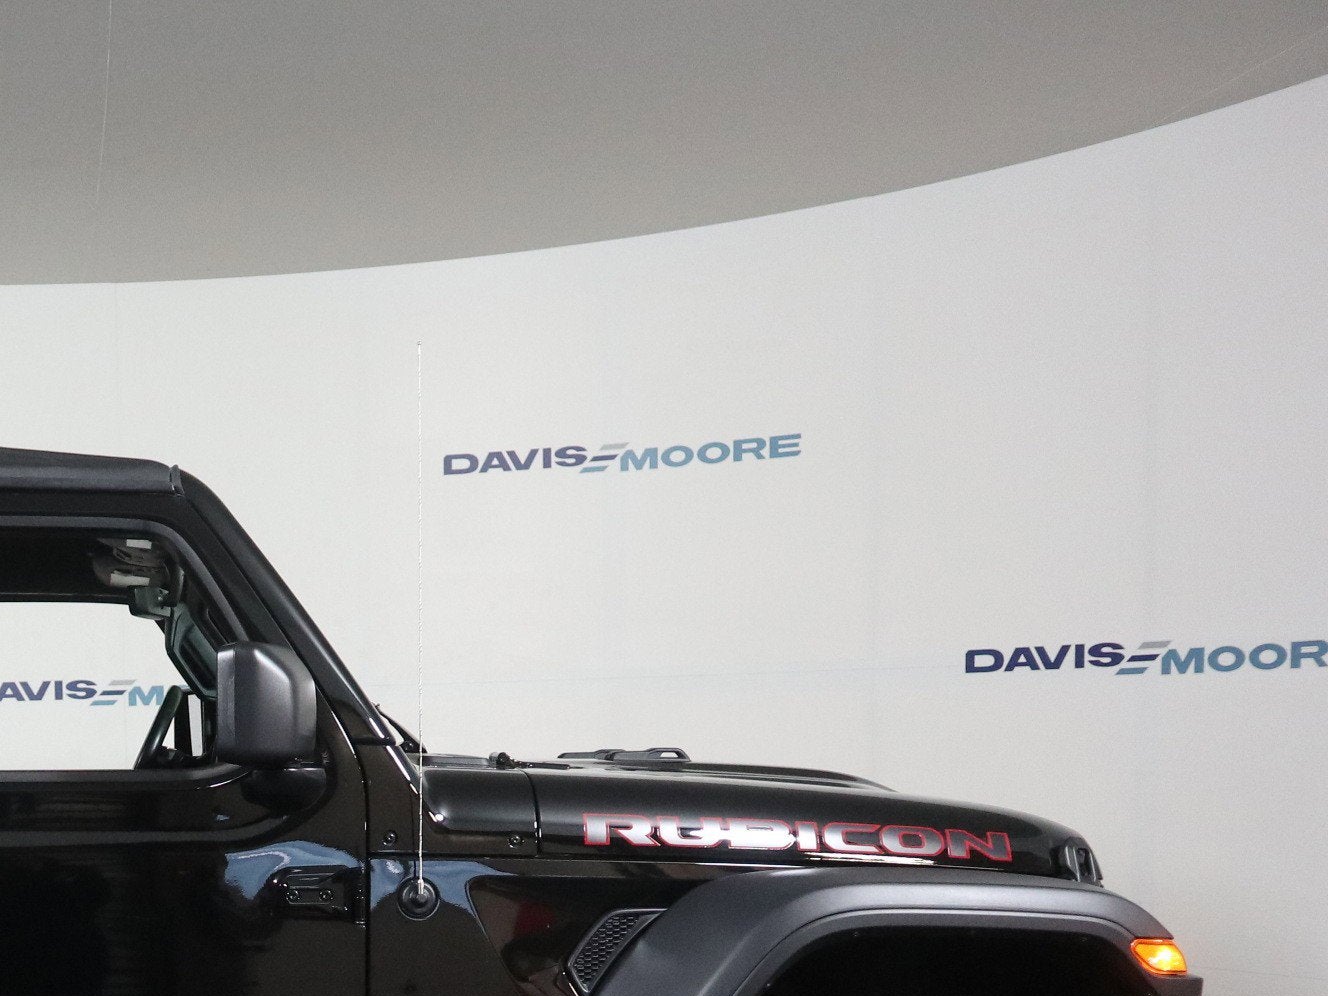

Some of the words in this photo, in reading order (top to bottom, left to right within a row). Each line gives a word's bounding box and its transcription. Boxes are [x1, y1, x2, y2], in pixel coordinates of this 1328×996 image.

[443, 445, 589, 476] DAVIS
[619, 433, 802, 472] MOORE
[965, 642, 1126, 674] DAVIS
[1160, 639, 1328, 675] MOOR
[582, 812, 1013, 862] RUBICON
